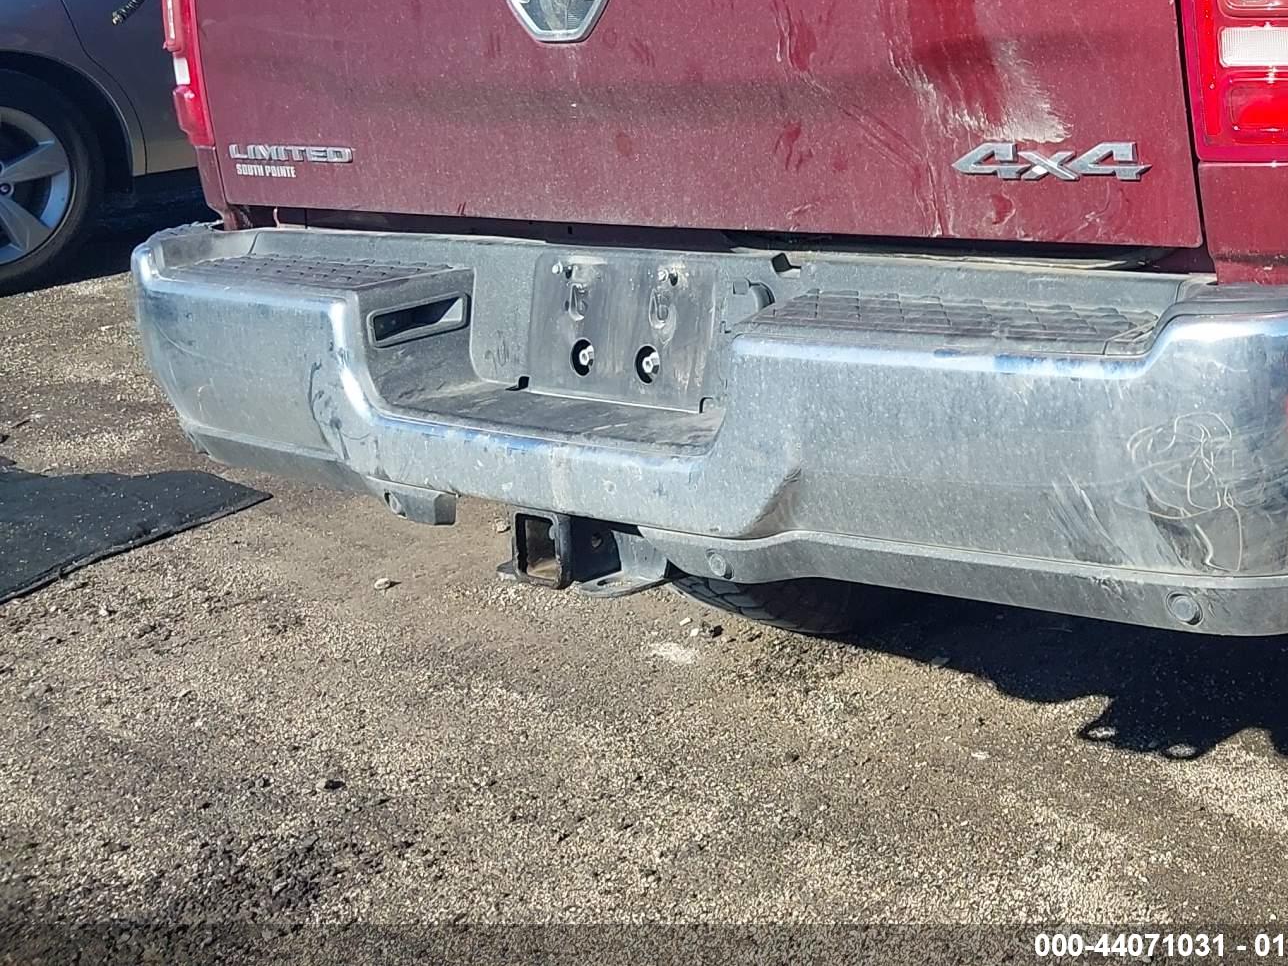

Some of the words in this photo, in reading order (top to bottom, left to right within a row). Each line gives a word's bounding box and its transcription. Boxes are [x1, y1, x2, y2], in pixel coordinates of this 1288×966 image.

[228, 143, 353, 163] LIMITED
[236, 163, 264, 176] SOUTH
[264, 165, 297, 178] POINTE
